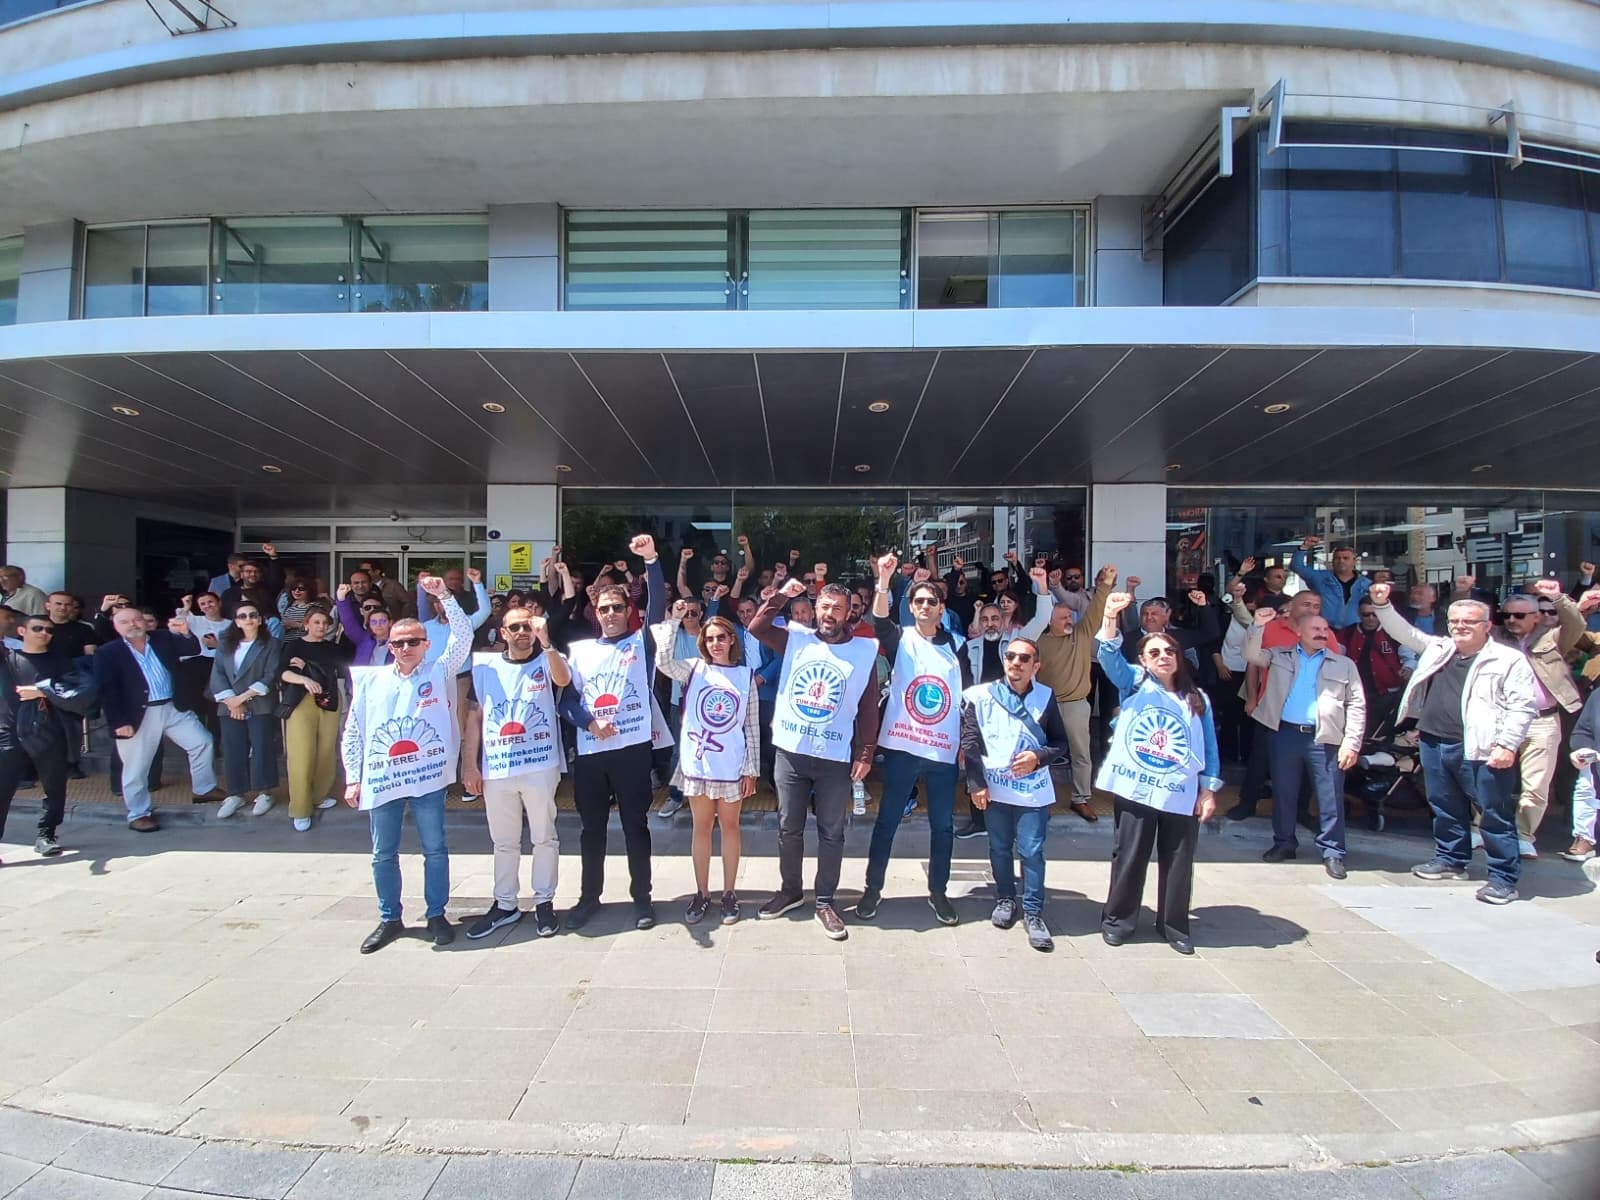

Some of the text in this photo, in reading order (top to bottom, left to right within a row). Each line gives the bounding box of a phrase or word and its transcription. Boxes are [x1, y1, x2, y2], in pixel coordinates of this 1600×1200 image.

[592, 707, 619, 717] YEREL
[626, 702, 642, 711] SEN
[497, 735, 527, 746] YEREL
[534, 731, 551, 741] SEN
[799, 725, 843, 741] BEL-SEN
[887, 729, 909, 739] ZAMAN
[930, 740, 952, 750] ZAMAN
[368, 760, 384, 770] TÜM
[386, 754, 420, 767] YEREL
[427, 746, 445, 757] SEN
[501, 744, 552, 759] Hareketinde
[392, 760, 447, 778] Hareketinde
[509, 760, 522, 768] Bir
[524, 754, 548, 764] Mevzi
[372, 770, 443, 794] Güçlü Bir Mevzi
